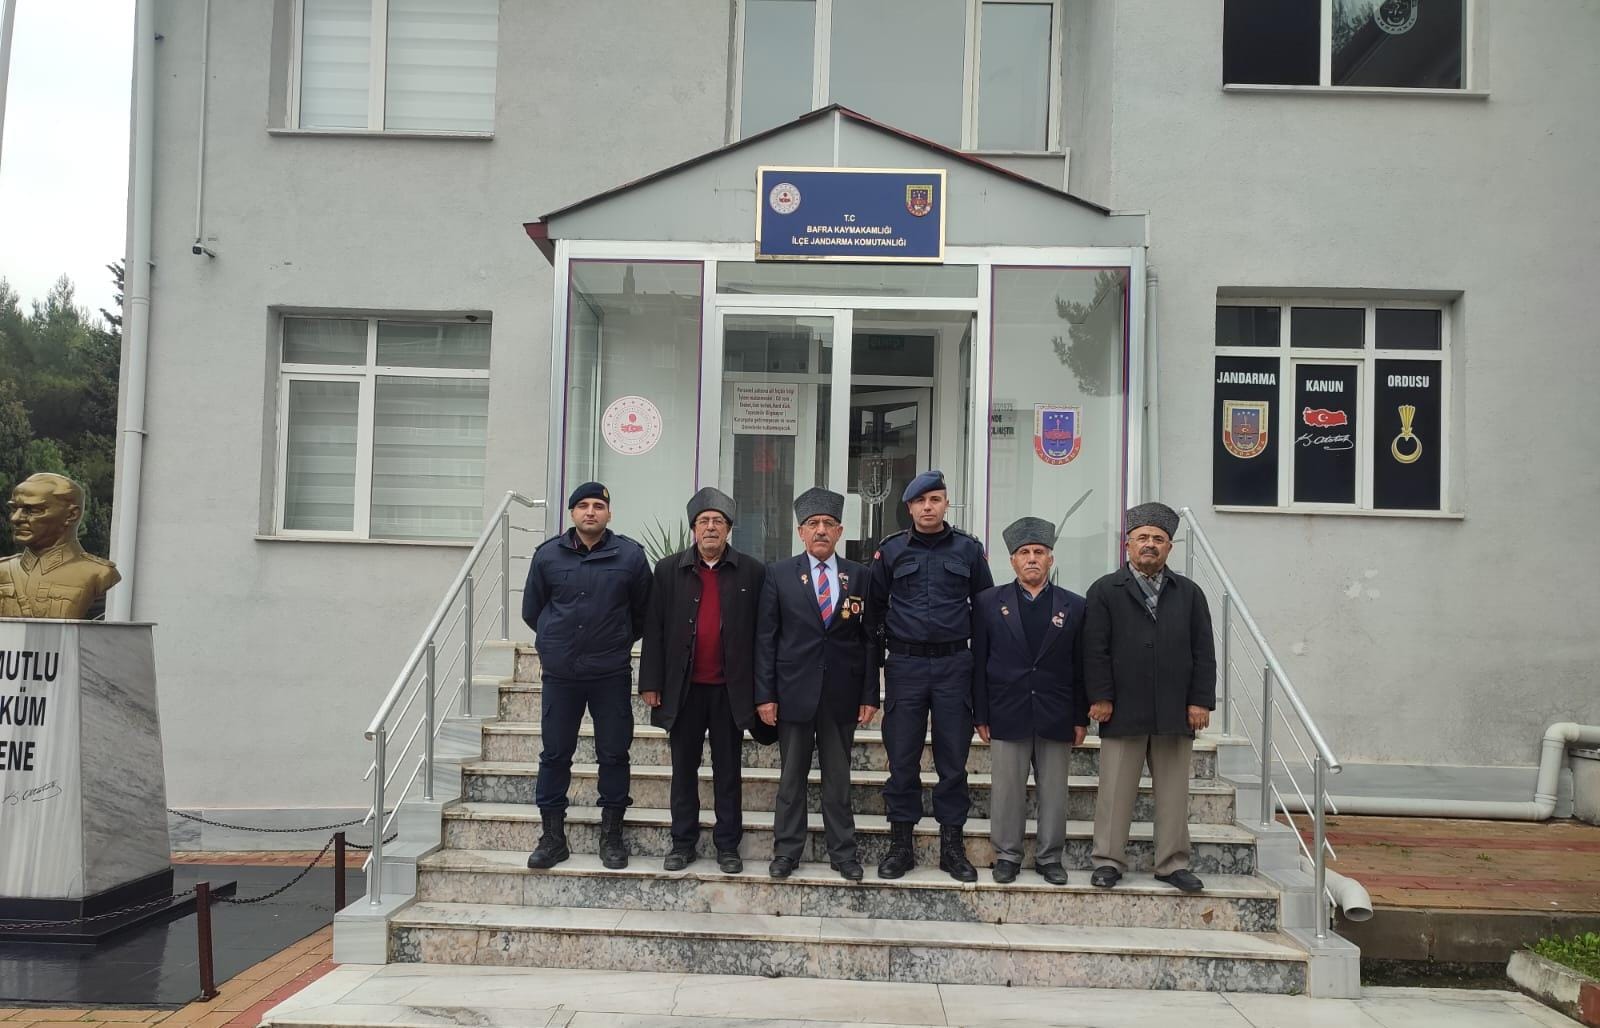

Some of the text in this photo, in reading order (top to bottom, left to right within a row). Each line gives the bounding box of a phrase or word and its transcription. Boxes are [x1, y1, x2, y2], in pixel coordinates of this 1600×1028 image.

[806, 225, 892, 234] BAFRA KAYMAKAMLIĞI
[791, 236, 907, 247] İLÇE JANDARMA KOMUTANLIĞI
[1216, 371, 1430, 393] JANDARMA KANUN ORDUSU
